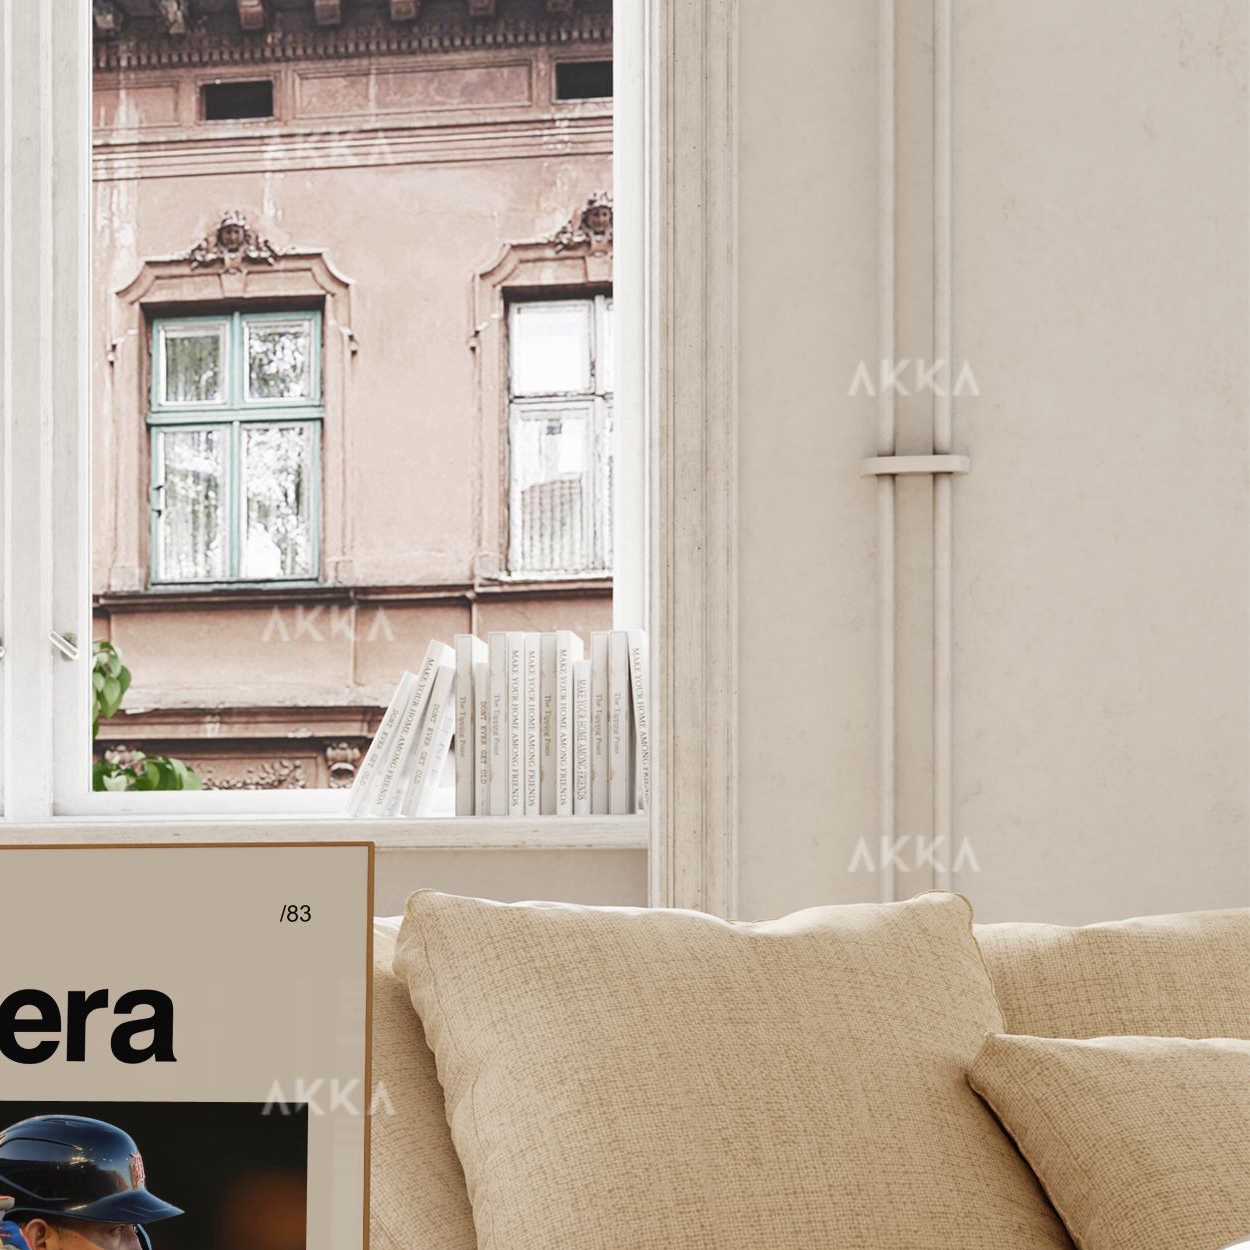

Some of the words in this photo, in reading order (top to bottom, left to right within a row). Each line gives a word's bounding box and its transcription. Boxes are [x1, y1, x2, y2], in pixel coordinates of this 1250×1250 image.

[420, 658, 435, 682] MAKE
[511, 649, 519, 675] MAKE
[559, 649, 567, 674] MAKE
[411, 684, 426, 708] YOUR
[511, 676, 519, 702] YOUR
[559, 675, 567, 701] YOUR
[402, 708, 416, 735] HOME
[430, 703, 440, 723] DONT
[511, 703, 519, 731] HOME
[559, 702, 567, 730] HOME
[423, 727, 434, 747] EVER
[511, 732, 519, 767] AMONG
[559, 731, 567, 766] AMONG
[390, 735, 406, 769] AMONG
[418, 751, 427, 766] GET
[376, 769, 394, 805] FRIENDS
[413, 769, 422, 785] OLD
[511, 768, 519, 806] FRIENDS
[559, 768, 567, 805] FRIENDS
[279, 904, 312, 924] /83
